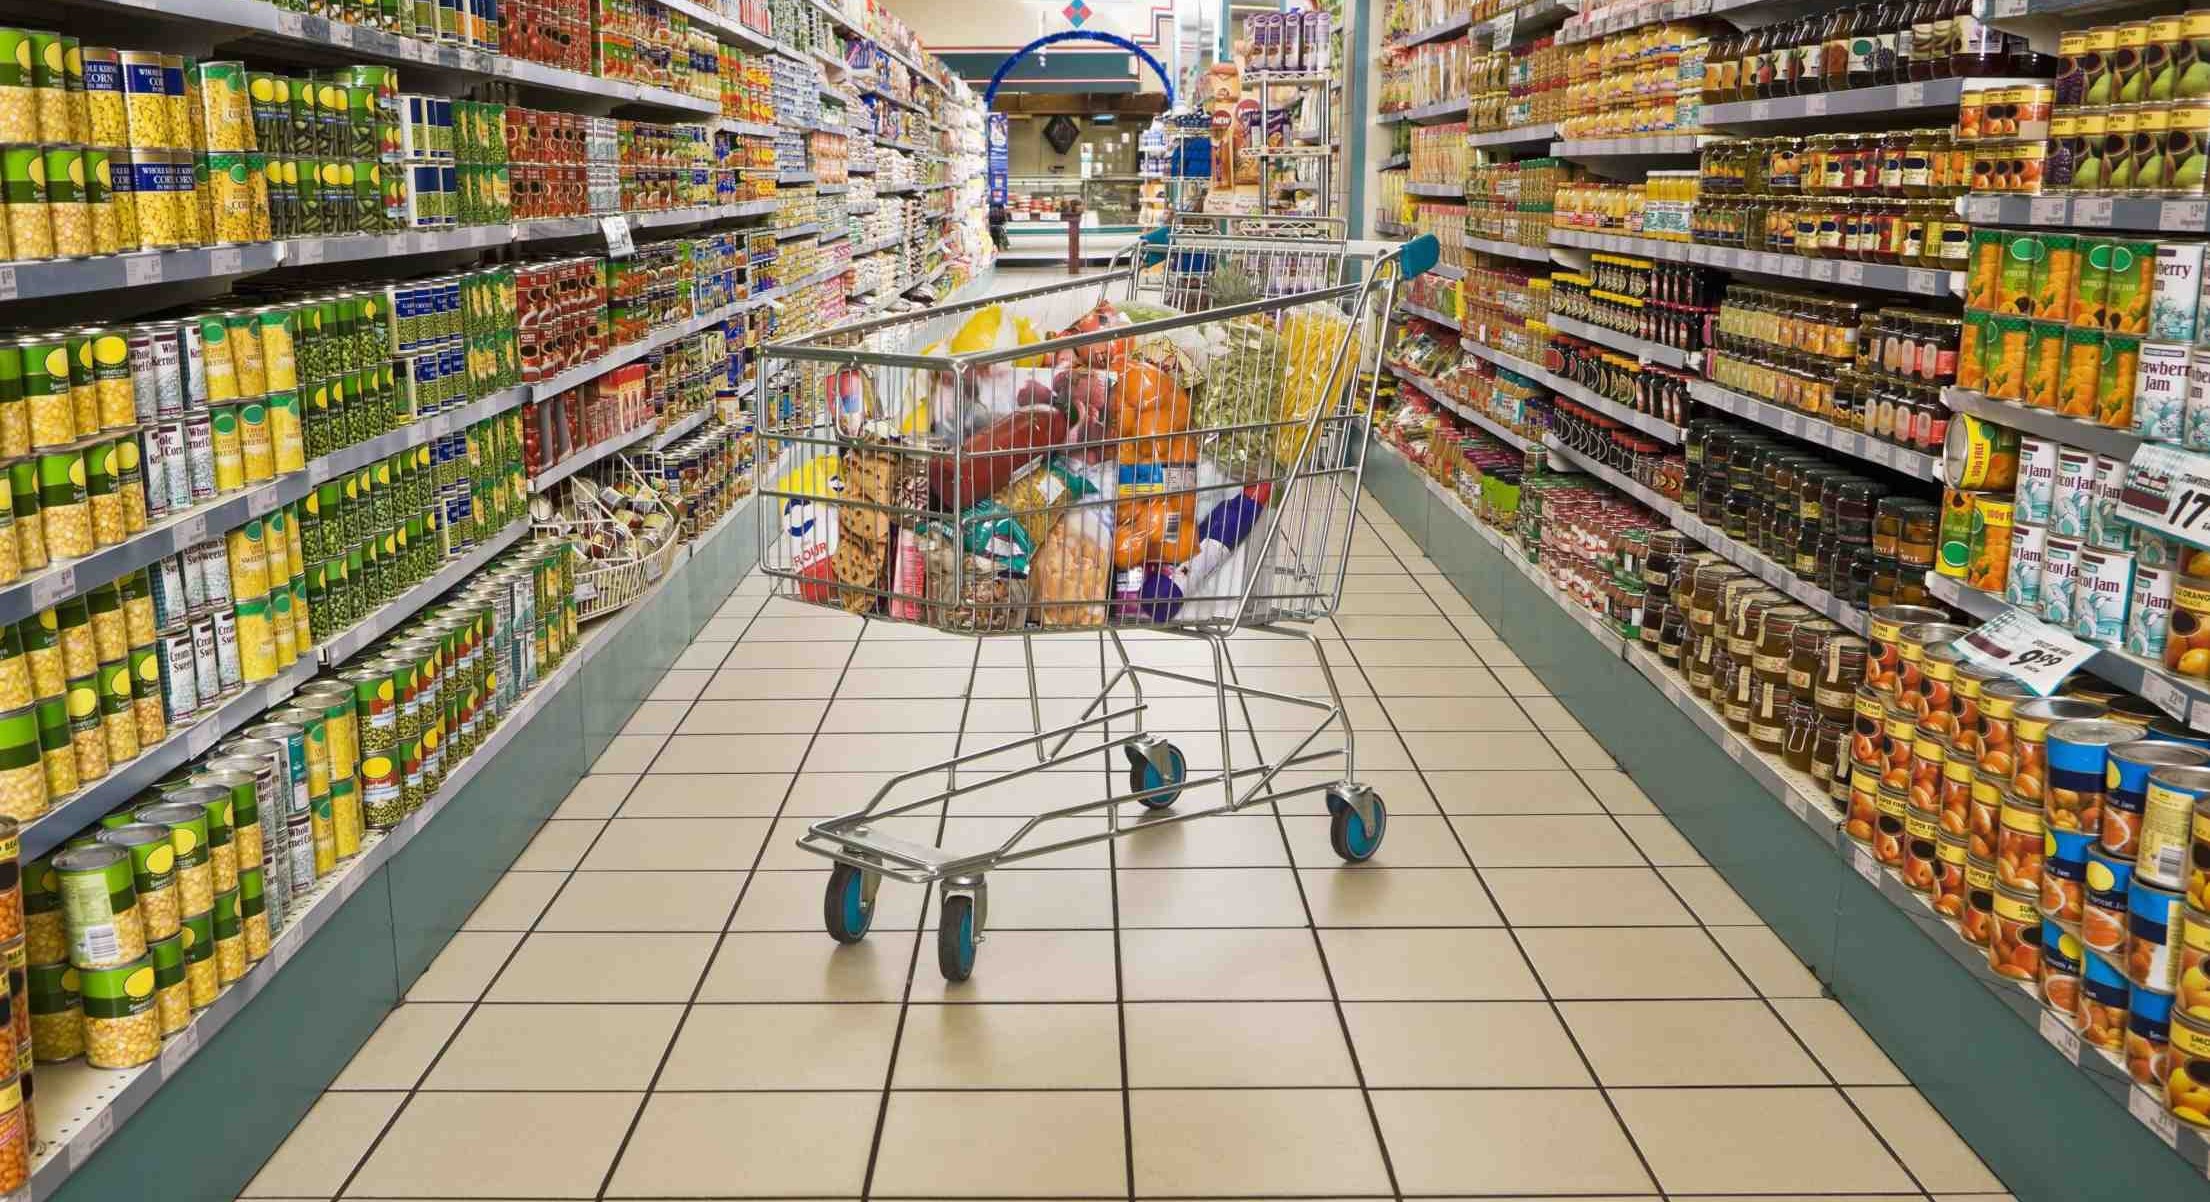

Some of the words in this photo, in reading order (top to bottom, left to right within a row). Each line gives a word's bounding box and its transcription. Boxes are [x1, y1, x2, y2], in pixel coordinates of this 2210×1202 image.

[2145, 375, 2171, 391] Jam
[1977, 443, 1985, 462] FREE
[2030, 463, 2051, 478] Jam
[2018, 547, 2041, 563] Jam
[2093, 576, 2120, 593] Jam
[2145, 594, 2172, 610] Jam
